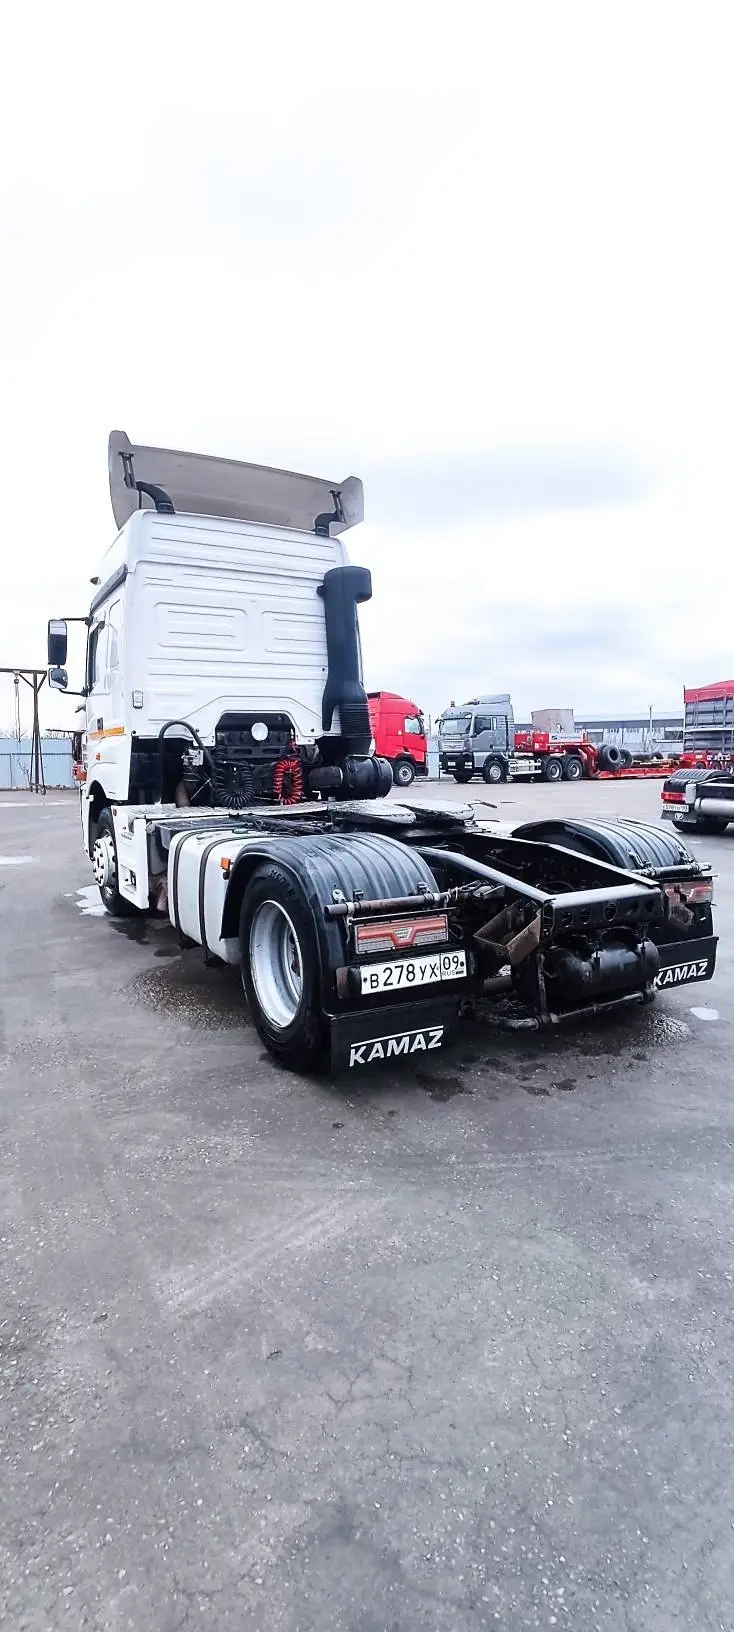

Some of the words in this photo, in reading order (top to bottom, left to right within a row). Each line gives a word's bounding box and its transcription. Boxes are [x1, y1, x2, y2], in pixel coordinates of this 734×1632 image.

[443, 955, 459, 970] 09
[653, 962, 708, 986] KAMAZ
[350, 1029, 444, 1067] KAMAZ
